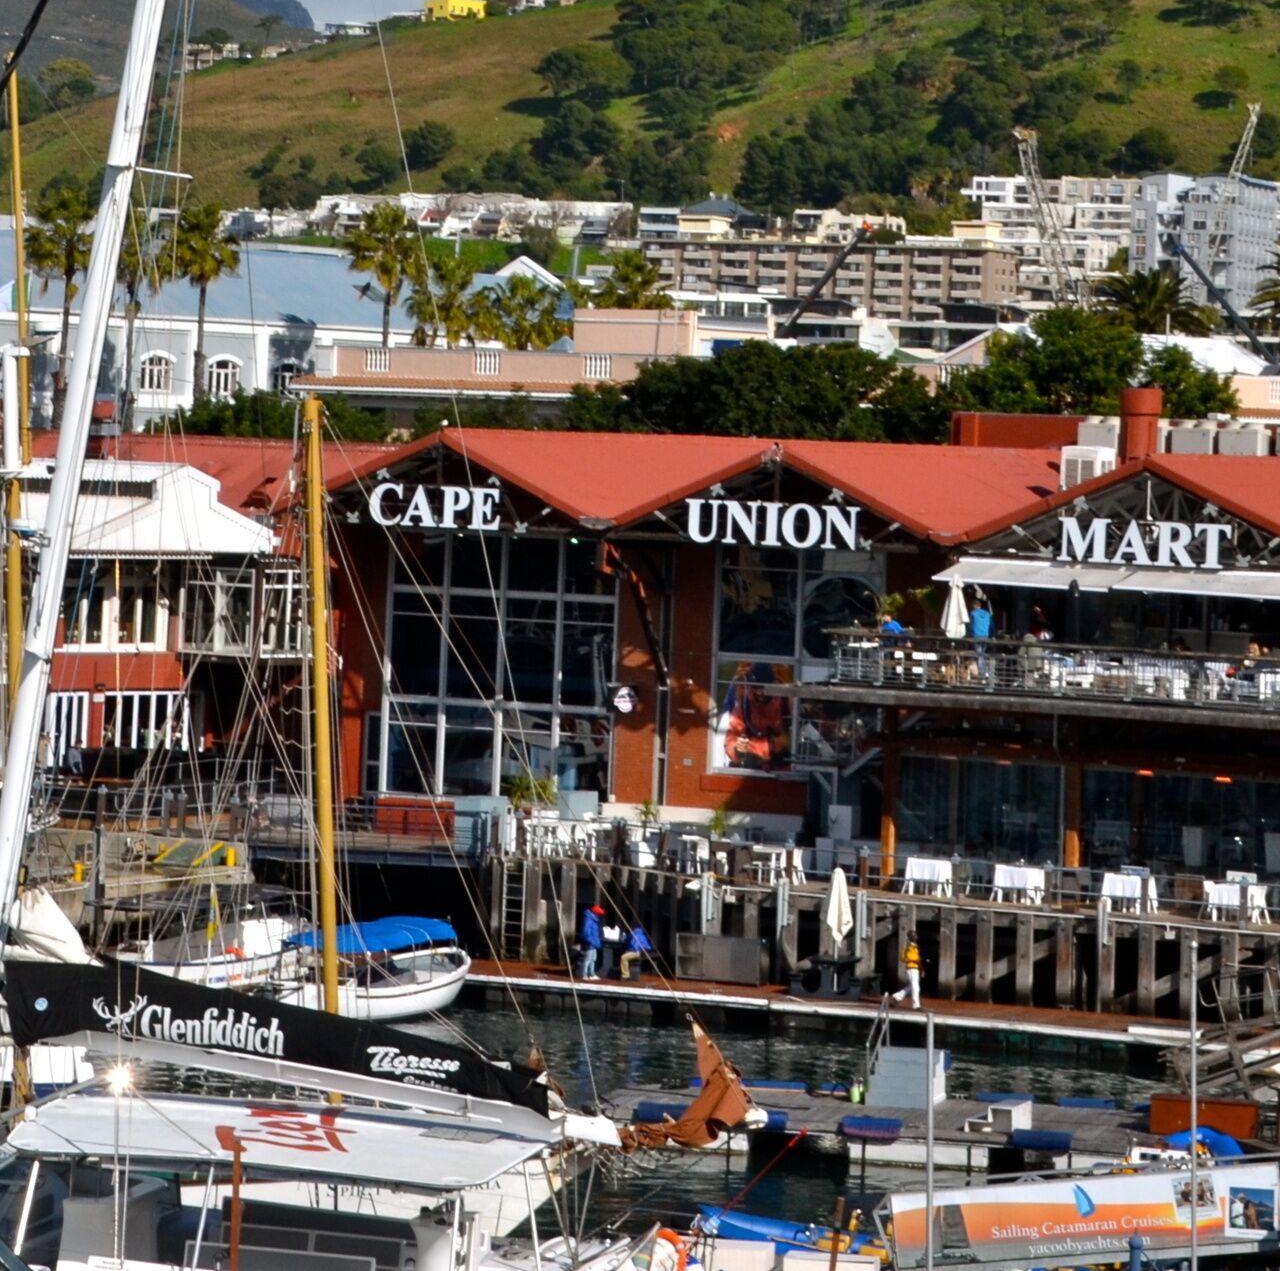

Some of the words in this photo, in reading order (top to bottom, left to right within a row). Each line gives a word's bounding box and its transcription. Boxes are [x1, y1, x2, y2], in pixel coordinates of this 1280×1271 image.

[369, 482, 501, 531] CAPE
[685, 498, 861, 551] UNION
[1057, 517, 1232, 569] MART
[140, 1004, 284, 1056] Glenfiddich
[367, 1046, 460, 1078] Tigresse
[992, 1224, 1040, 1240] Sailing
[1042, 1220, 1117, 1237] Catamaran
[1121, 1215, 1172, 1229] Cruises
[1028, 1235, 1151, 1258] yacoobyachts.cm
